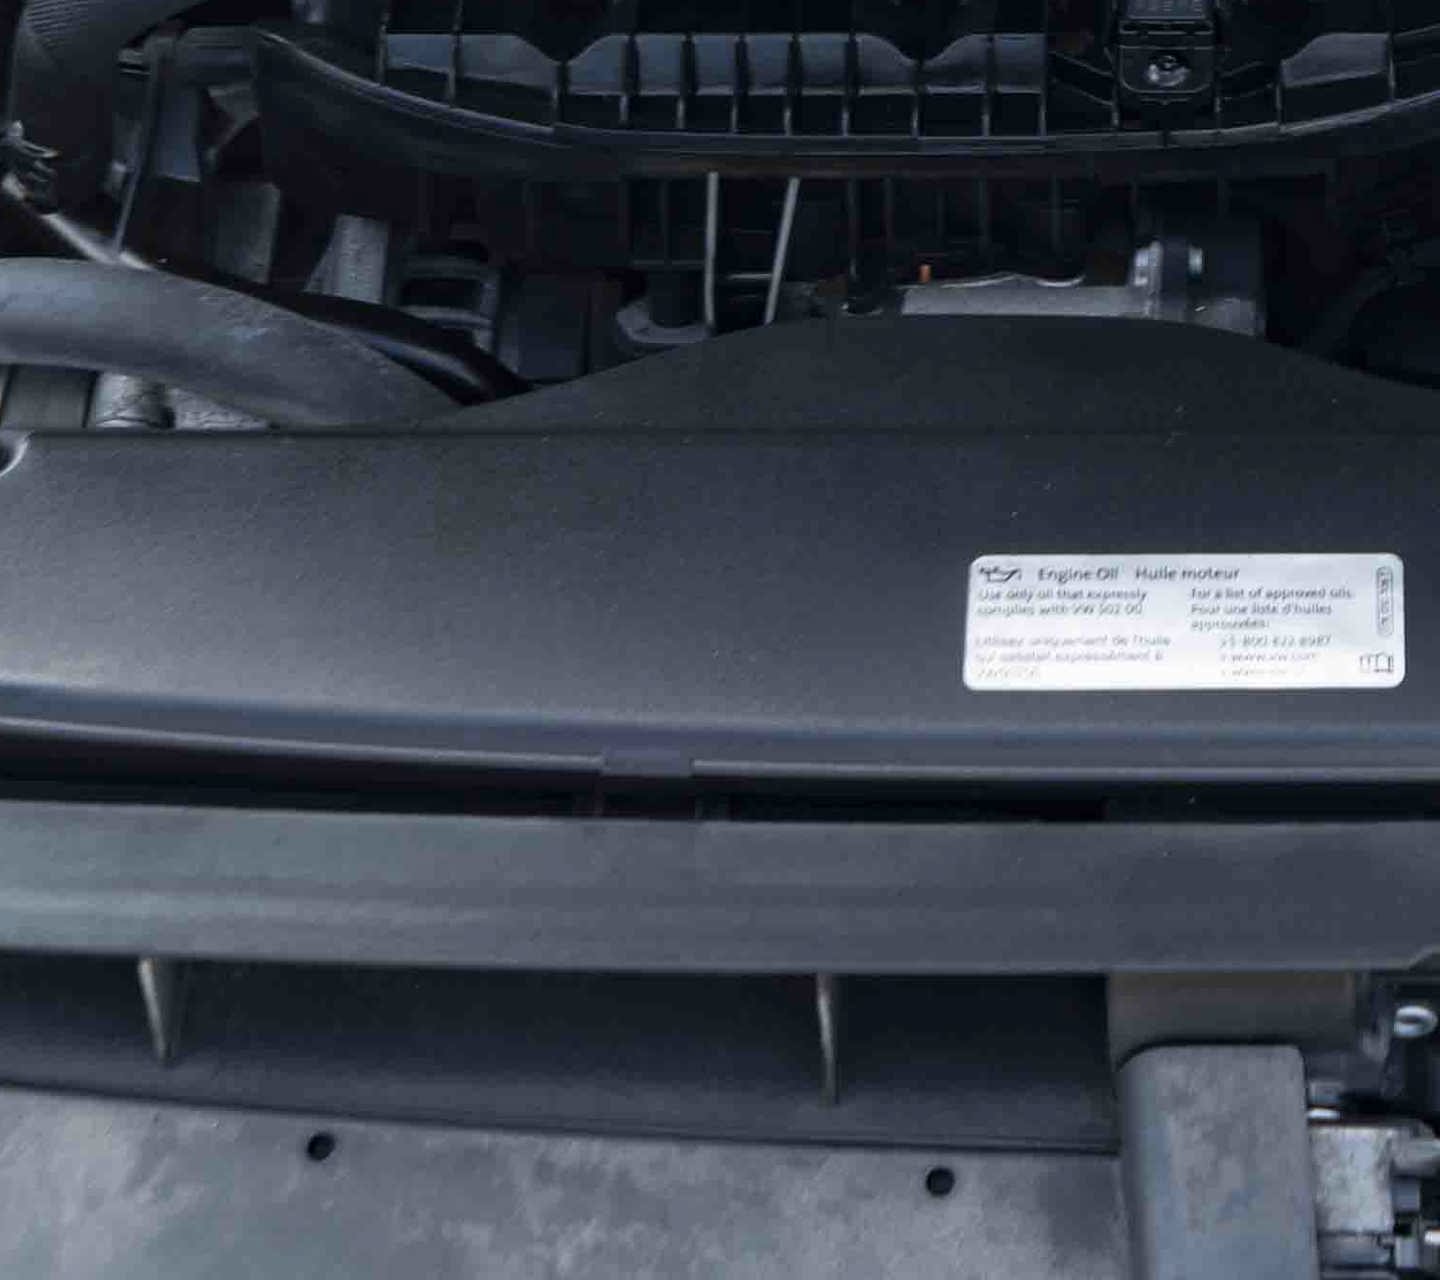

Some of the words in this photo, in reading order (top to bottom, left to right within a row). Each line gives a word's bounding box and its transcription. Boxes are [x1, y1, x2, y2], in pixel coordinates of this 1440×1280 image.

[1038, 566, 1092, 585] Engine
[1096, 566, 1119, 581] Oil
[1136, 566, 1179, 580] Huile
[1182, 567, 1240, 580] moteur
[1248, 586, 1263, 598] of
[1266, 586, 1326, 601] approved
